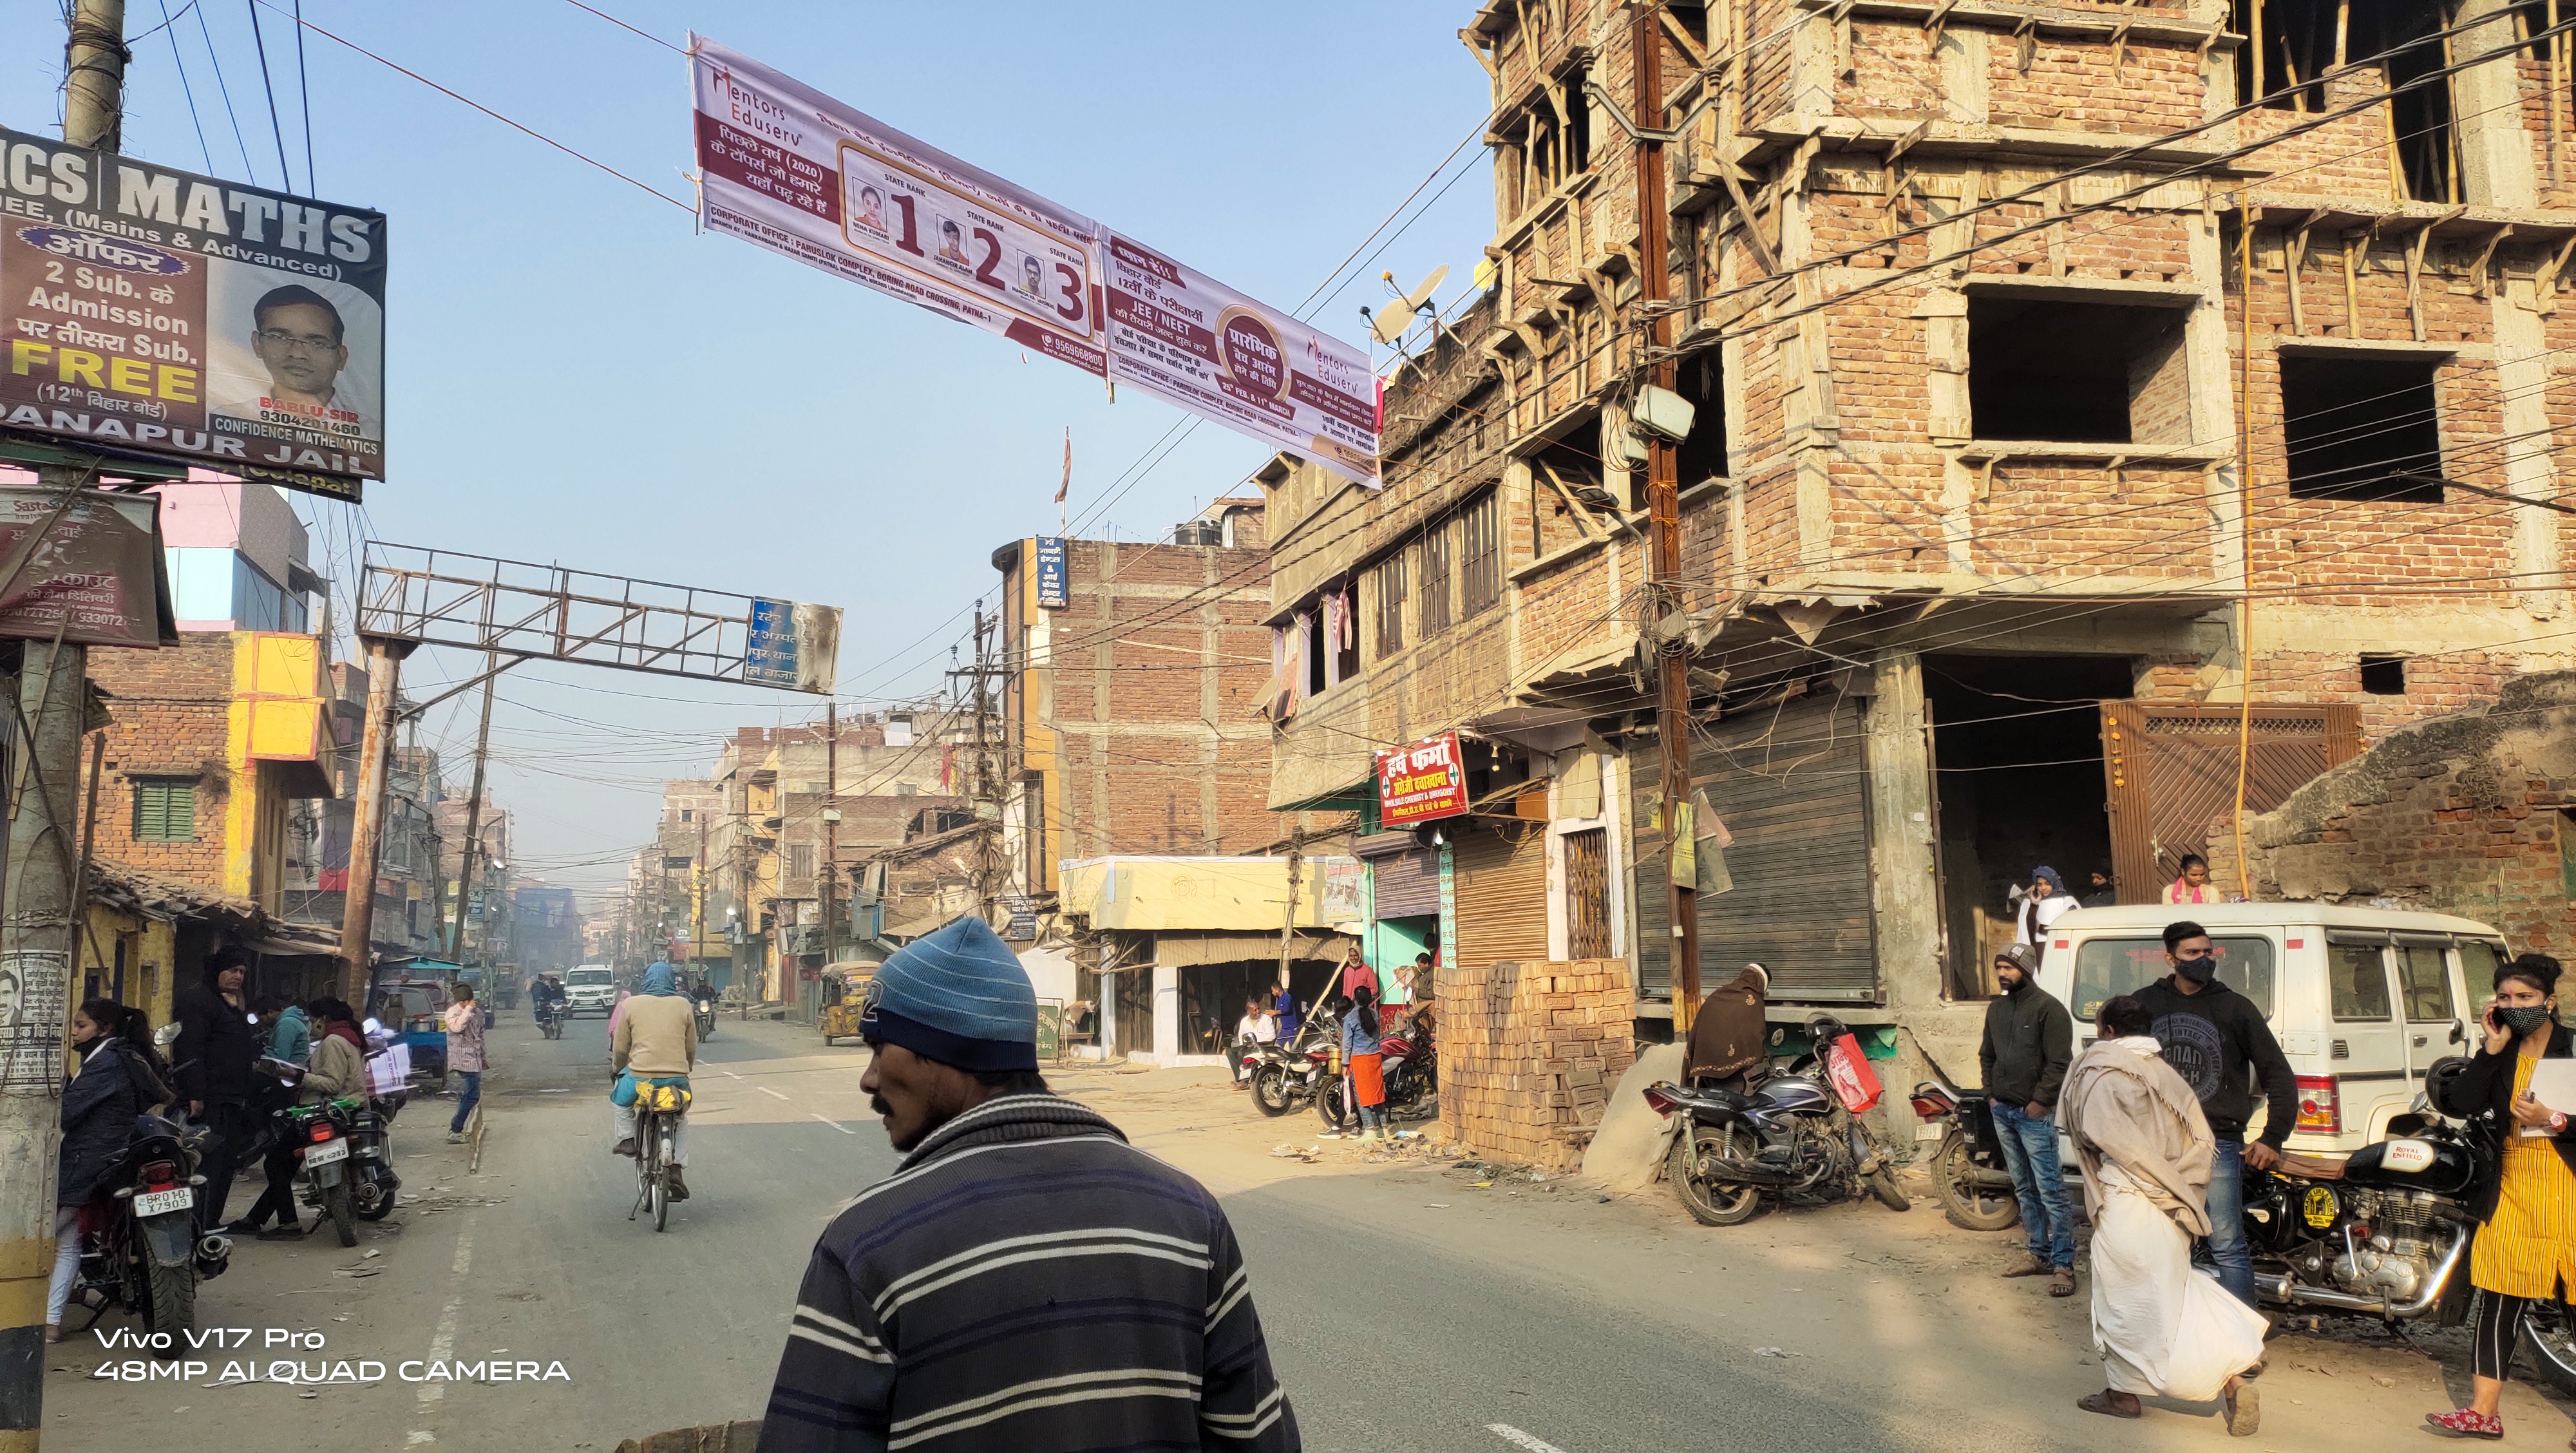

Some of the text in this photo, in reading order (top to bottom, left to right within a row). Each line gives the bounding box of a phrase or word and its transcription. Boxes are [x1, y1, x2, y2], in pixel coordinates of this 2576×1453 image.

[710, 140, 822, 196] के टॉपर्स जो हमारे
[719, 124, 823, 183] पिछले वर्ष (2020)
[746, 171, 772, 191] यहाँ
[796, 193, 813, 209] रहे
[816, 198, 827, 214] हैं
[884, 173, 926, 197] STATE RANK
[117, 165, 372, 263] MATHS
[711, 218, 733, 231] BRANCH
[853, 221, 868, 233] NEHA
[869, 229, 889, 240] KUMARI
[891, 194, 925, 258] 1
[967, 211, 1004, 233] STATE RANK
[0, 195, 342, 282] EE, (Mains & Advanced)
[45, 234, 164, 273] ऑफर
[1049, 247, 1084, 267] STATE RANK
[711, 206, 759, 232] CORPORATE
[762, 226, 790, 243] OFFICE
[838, 257, 875, 278] COMPLEX,
[877, 272, 904, 287] BORING
[905, 282, 924, 296] ROAD
[925, 290, 961, 312] CROSSING,
[973, 227, 1006, 291] 2
[46, 261, 175, 305] 2 Sub. के
[1056, 263, 1084, 321] 3
[1144, 287, 1157, 301] के
[28, 287, 189, 335] Admission
[1115, 308, 1128, 319] की
[1132, 301, 1190, 336] JEE NEET
[15, 318, 197, 365] पर तीसरा Sub.
[12, 339, 197, 404] FREE
[1118, 356, 1150, 374] CORPORATE
[1151, 370, 1169, 383] OFFICE
[86, 392, 129, 412] बिहार
[133, 397, 167, 422] बोर्ड)
[260, 397, 359, 424] BABLU SIR
[260, 410, 361, 436] 9304201460
[1269, 401, 1291, 417] MARCH
[0, 403, 375, 477] ANAPUR JAIL
[214, 417, 377, 455] CONFIDENCE MATHEMATICS
[2392, 1152, 2423, 1161] ENFIELD
